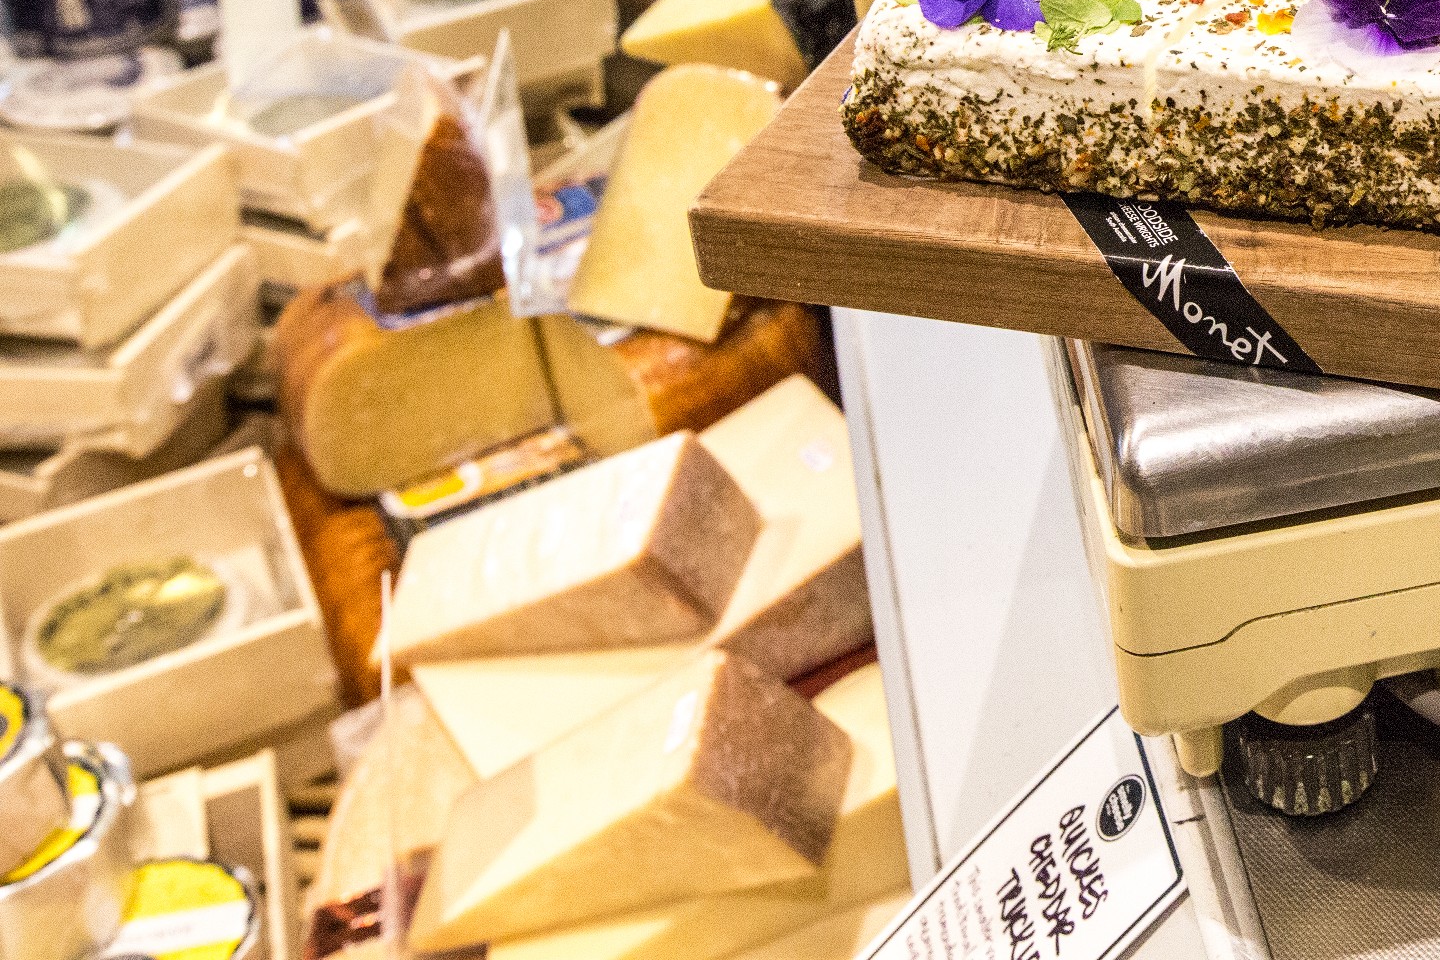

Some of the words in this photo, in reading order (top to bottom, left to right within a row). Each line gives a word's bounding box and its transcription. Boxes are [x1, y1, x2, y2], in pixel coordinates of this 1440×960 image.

[1133, 221, 1160, 248] WRIGHTS
[1138, 202, 1179, 245] OODSIDE
[1142, 254, 1288, 365] Monet
[1028, 833, 1075, 956] CHEDDAR
